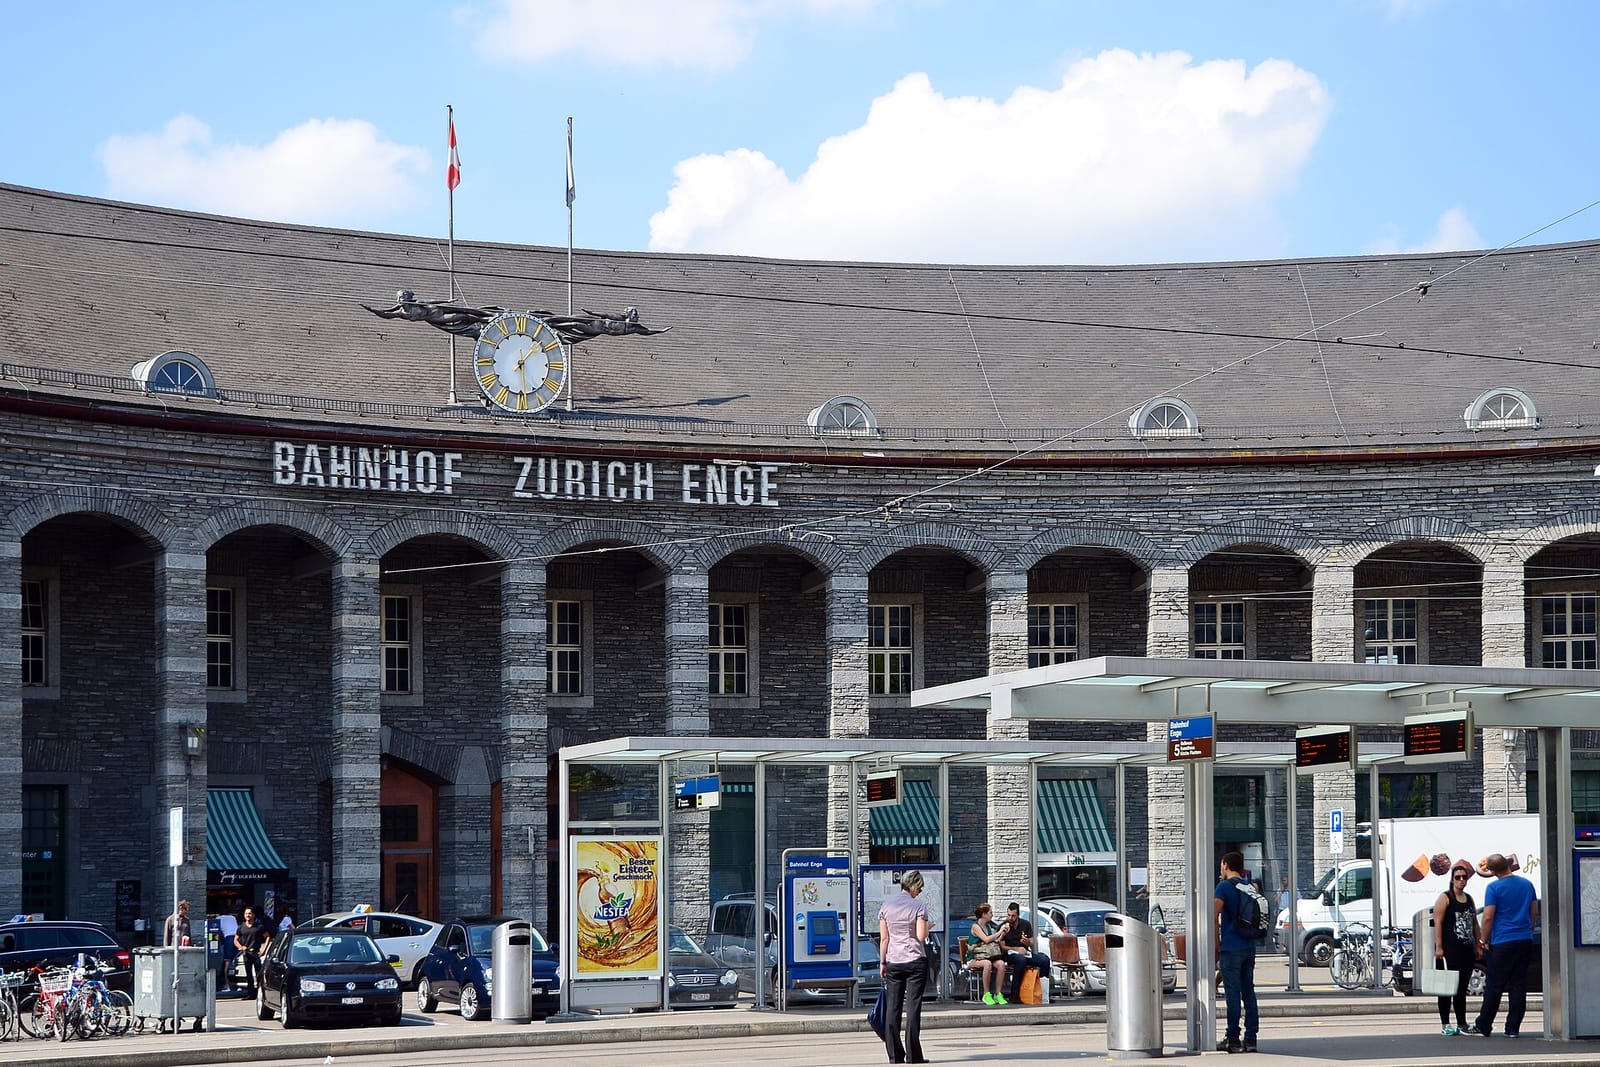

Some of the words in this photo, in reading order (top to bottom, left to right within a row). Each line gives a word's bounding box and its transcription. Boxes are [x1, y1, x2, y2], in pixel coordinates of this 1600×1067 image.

[273, 441, 463, 495] BAHNHOF
[682, 463, 779, 507] ENGE
[1170, 720, 1190, 729] Bahnhof
[1170, 730, 1183, 738] Enge
[1174, 744, 1180, 757] 5
[1334, 814, 1340, 830] P
[629, 858, 656, 866] Bester
[619, 864, 649, 874] Eistee
[613, 871, 653, 882] Geschmack
[596, 906, 629, 917] NESTEA
